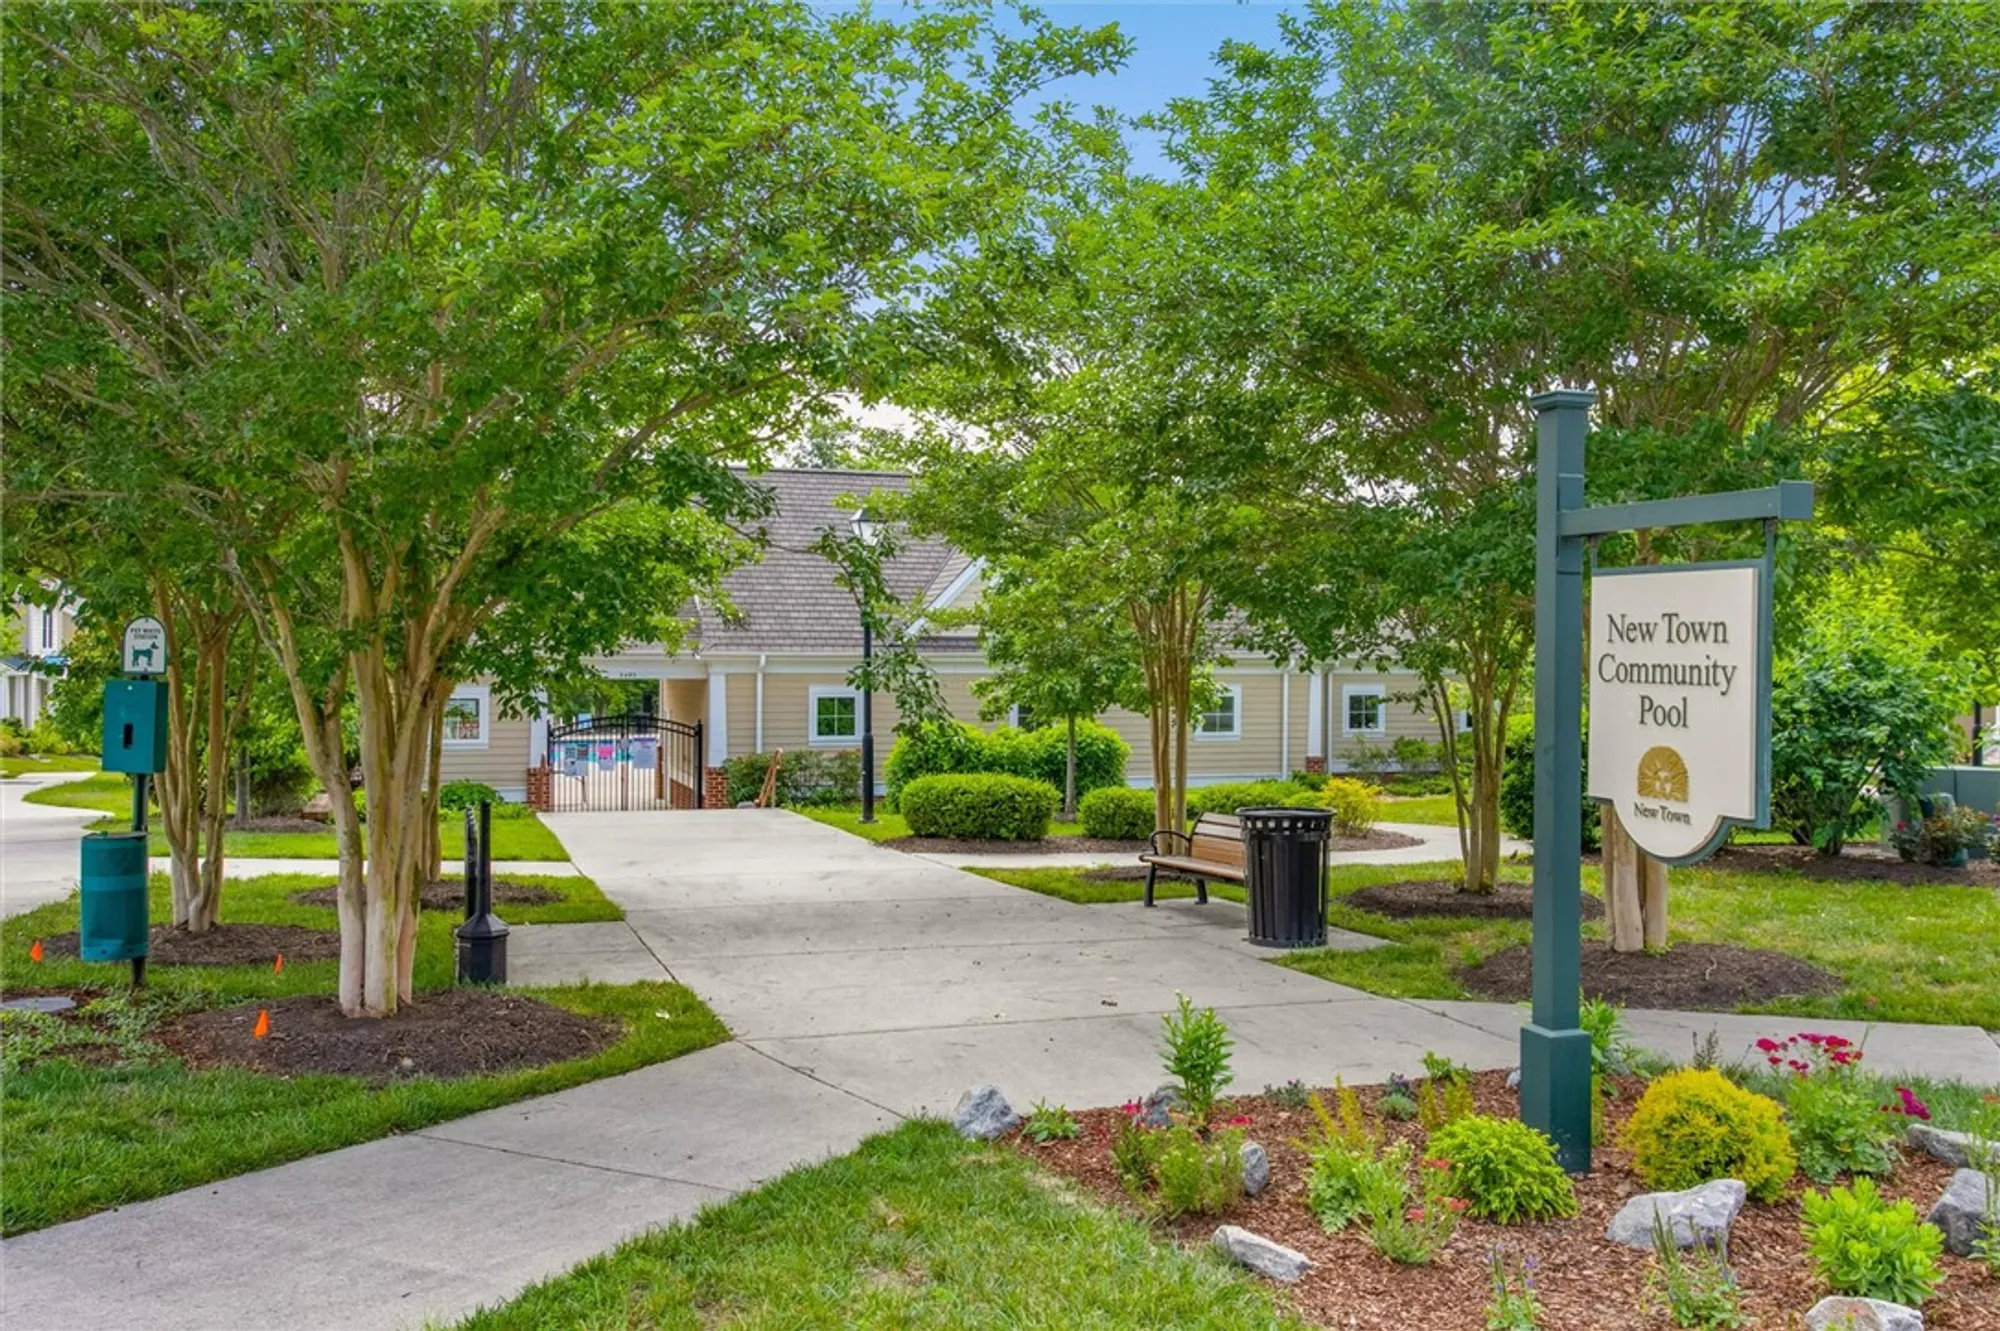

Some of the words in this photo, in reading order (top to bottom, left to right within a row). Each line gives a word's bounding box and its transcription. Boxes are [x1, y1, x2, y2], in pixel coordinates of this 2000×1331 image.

[1607, 613, 1658, 644] New
[1661, 612, 1728, 644] Town
[1598, 653, 1737, 697] Community
[1638, 694, 1689, 729] Pool
[1633, 800, 1660, 818] New
[1659, 804, 1692, 827] Town
